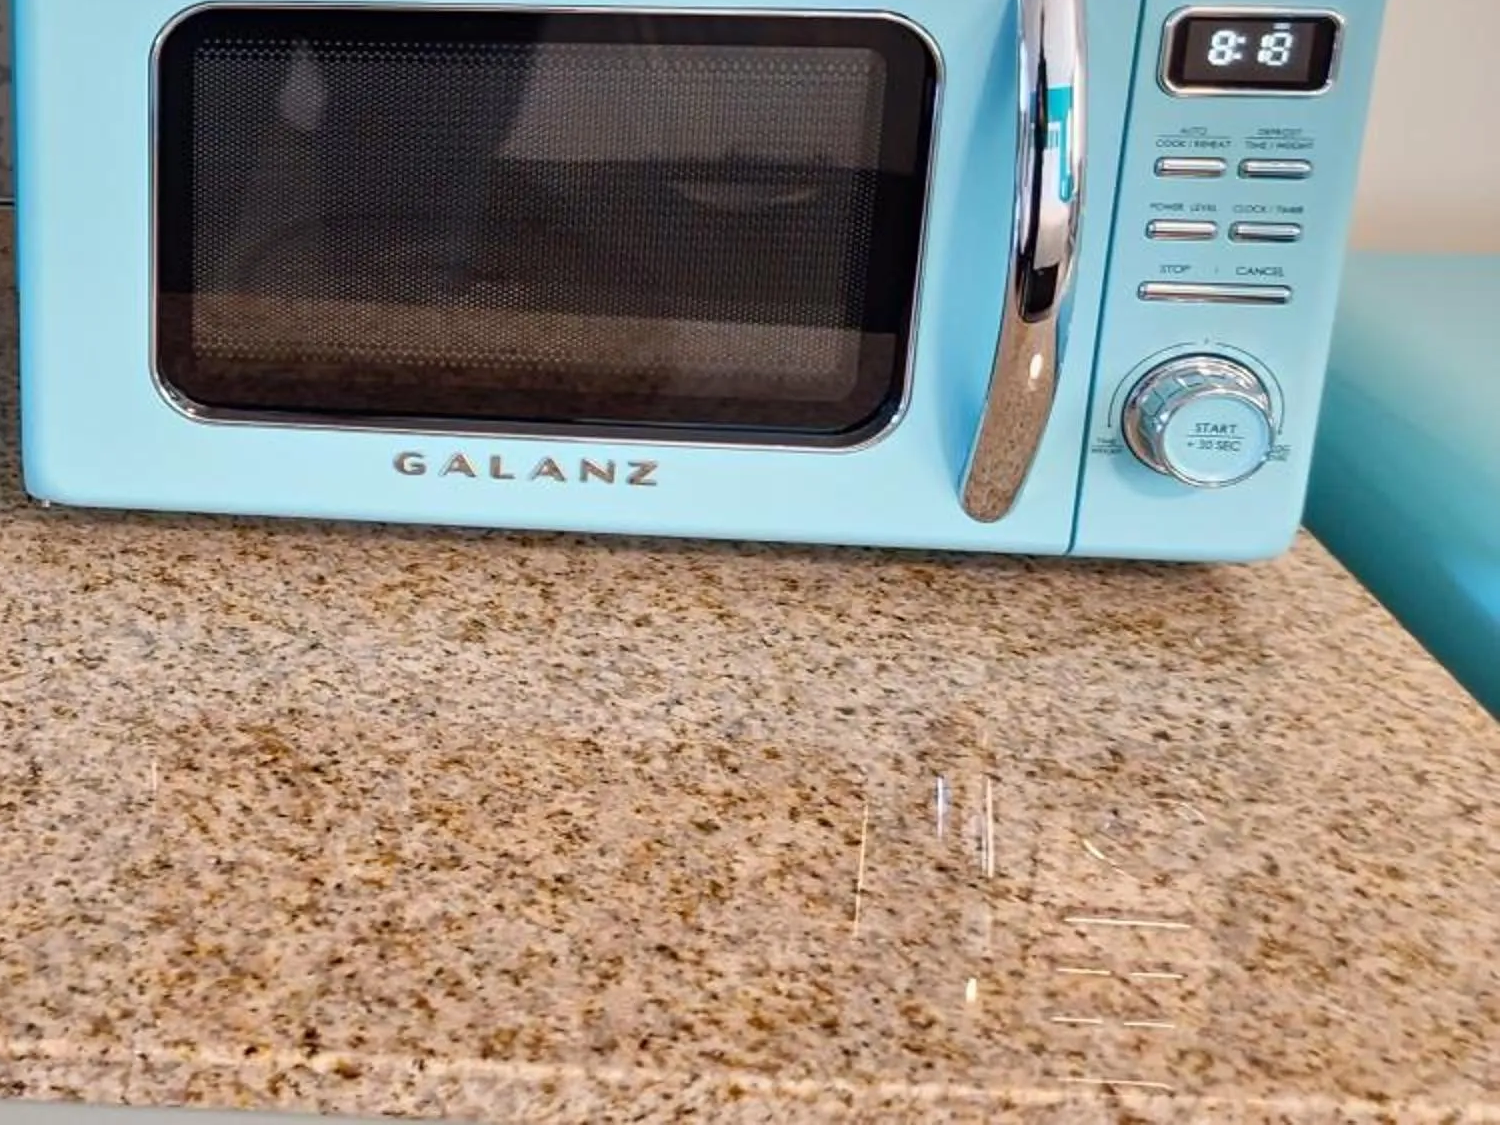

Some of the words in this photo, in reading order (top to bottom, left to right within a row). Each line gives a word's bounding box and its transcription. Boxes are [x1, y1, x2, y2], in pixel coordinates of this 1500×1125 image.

[1156, 139, 1187, 148] COOK
[1159, 264, 1191, 274] STOP
[1235, 266, 1285, 277] CANCEL
[1195, 422, 1237, 434] START
[1214, 440, 1241, 452] SEC
[393, 451, 659, 487] GALANZ
